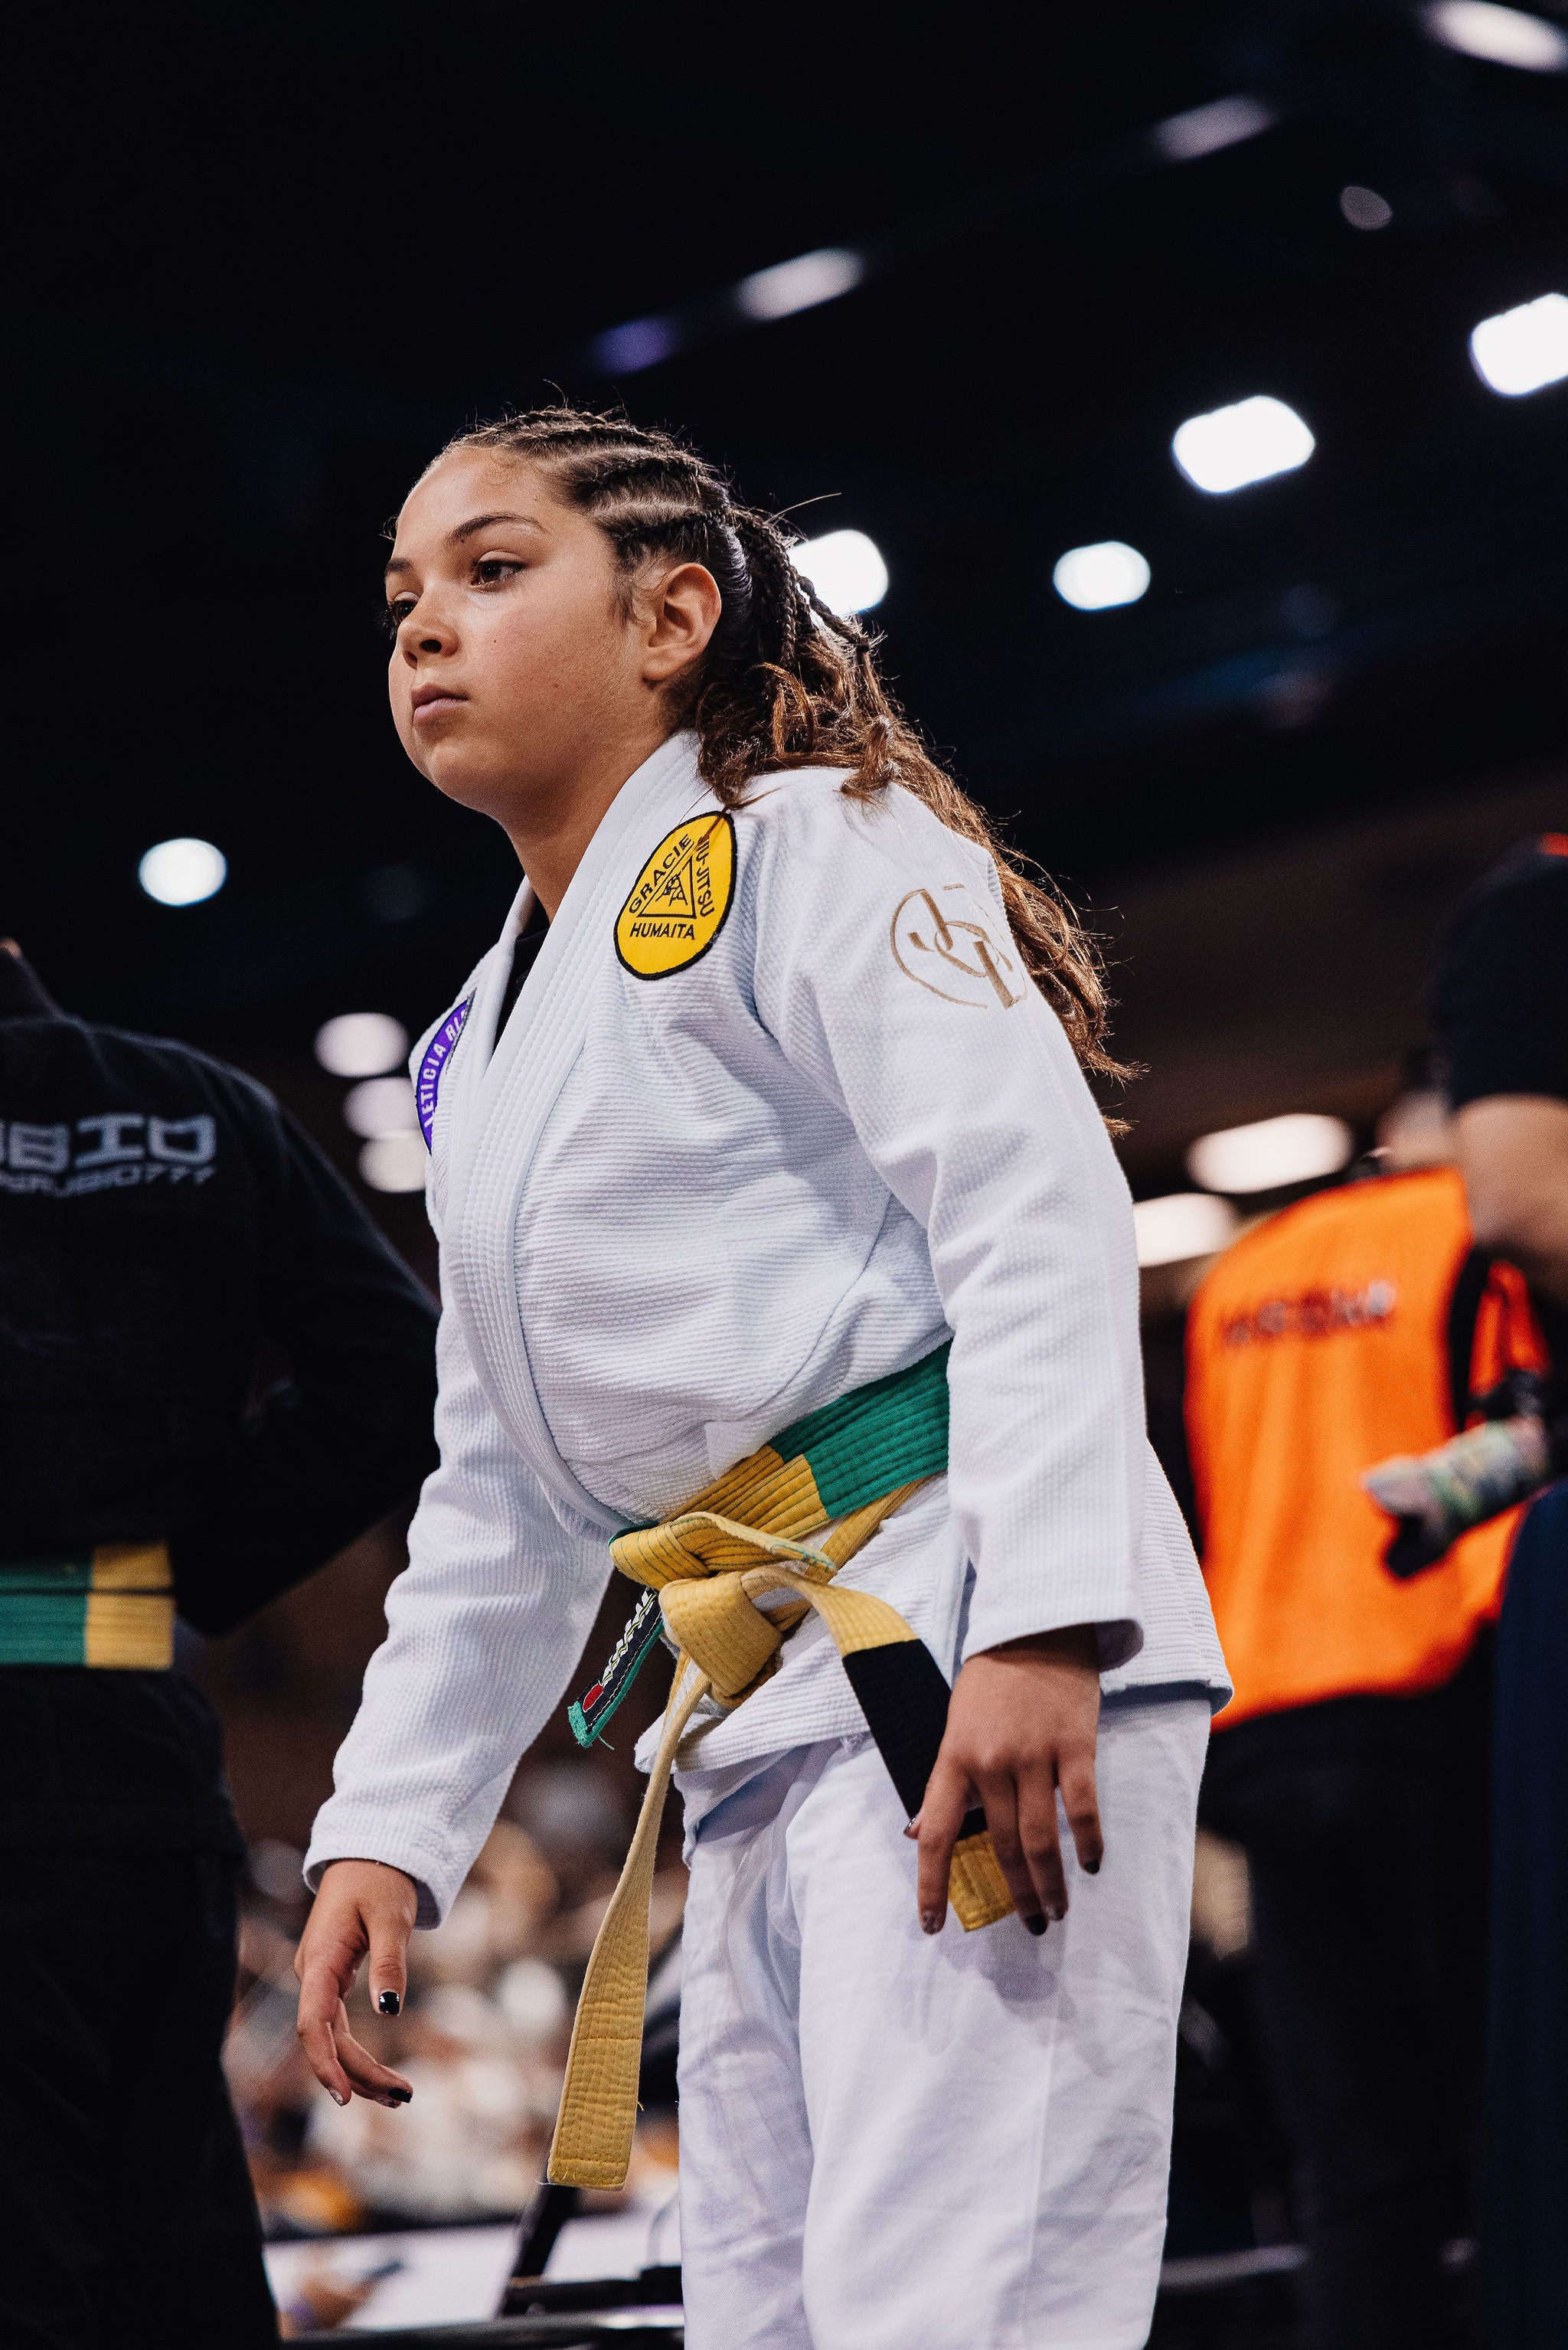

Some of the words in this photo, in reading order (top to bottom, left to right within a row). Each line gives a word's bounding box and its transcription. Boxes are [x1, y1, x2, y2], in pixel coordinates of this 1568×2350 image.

[629, 833, 692, 914] GRACIE
[629, 922, 695, 940] HUMAITA
[420, 1042, 446, 1128] LETICIA
[0, 1112, 217, 1175] BIO
